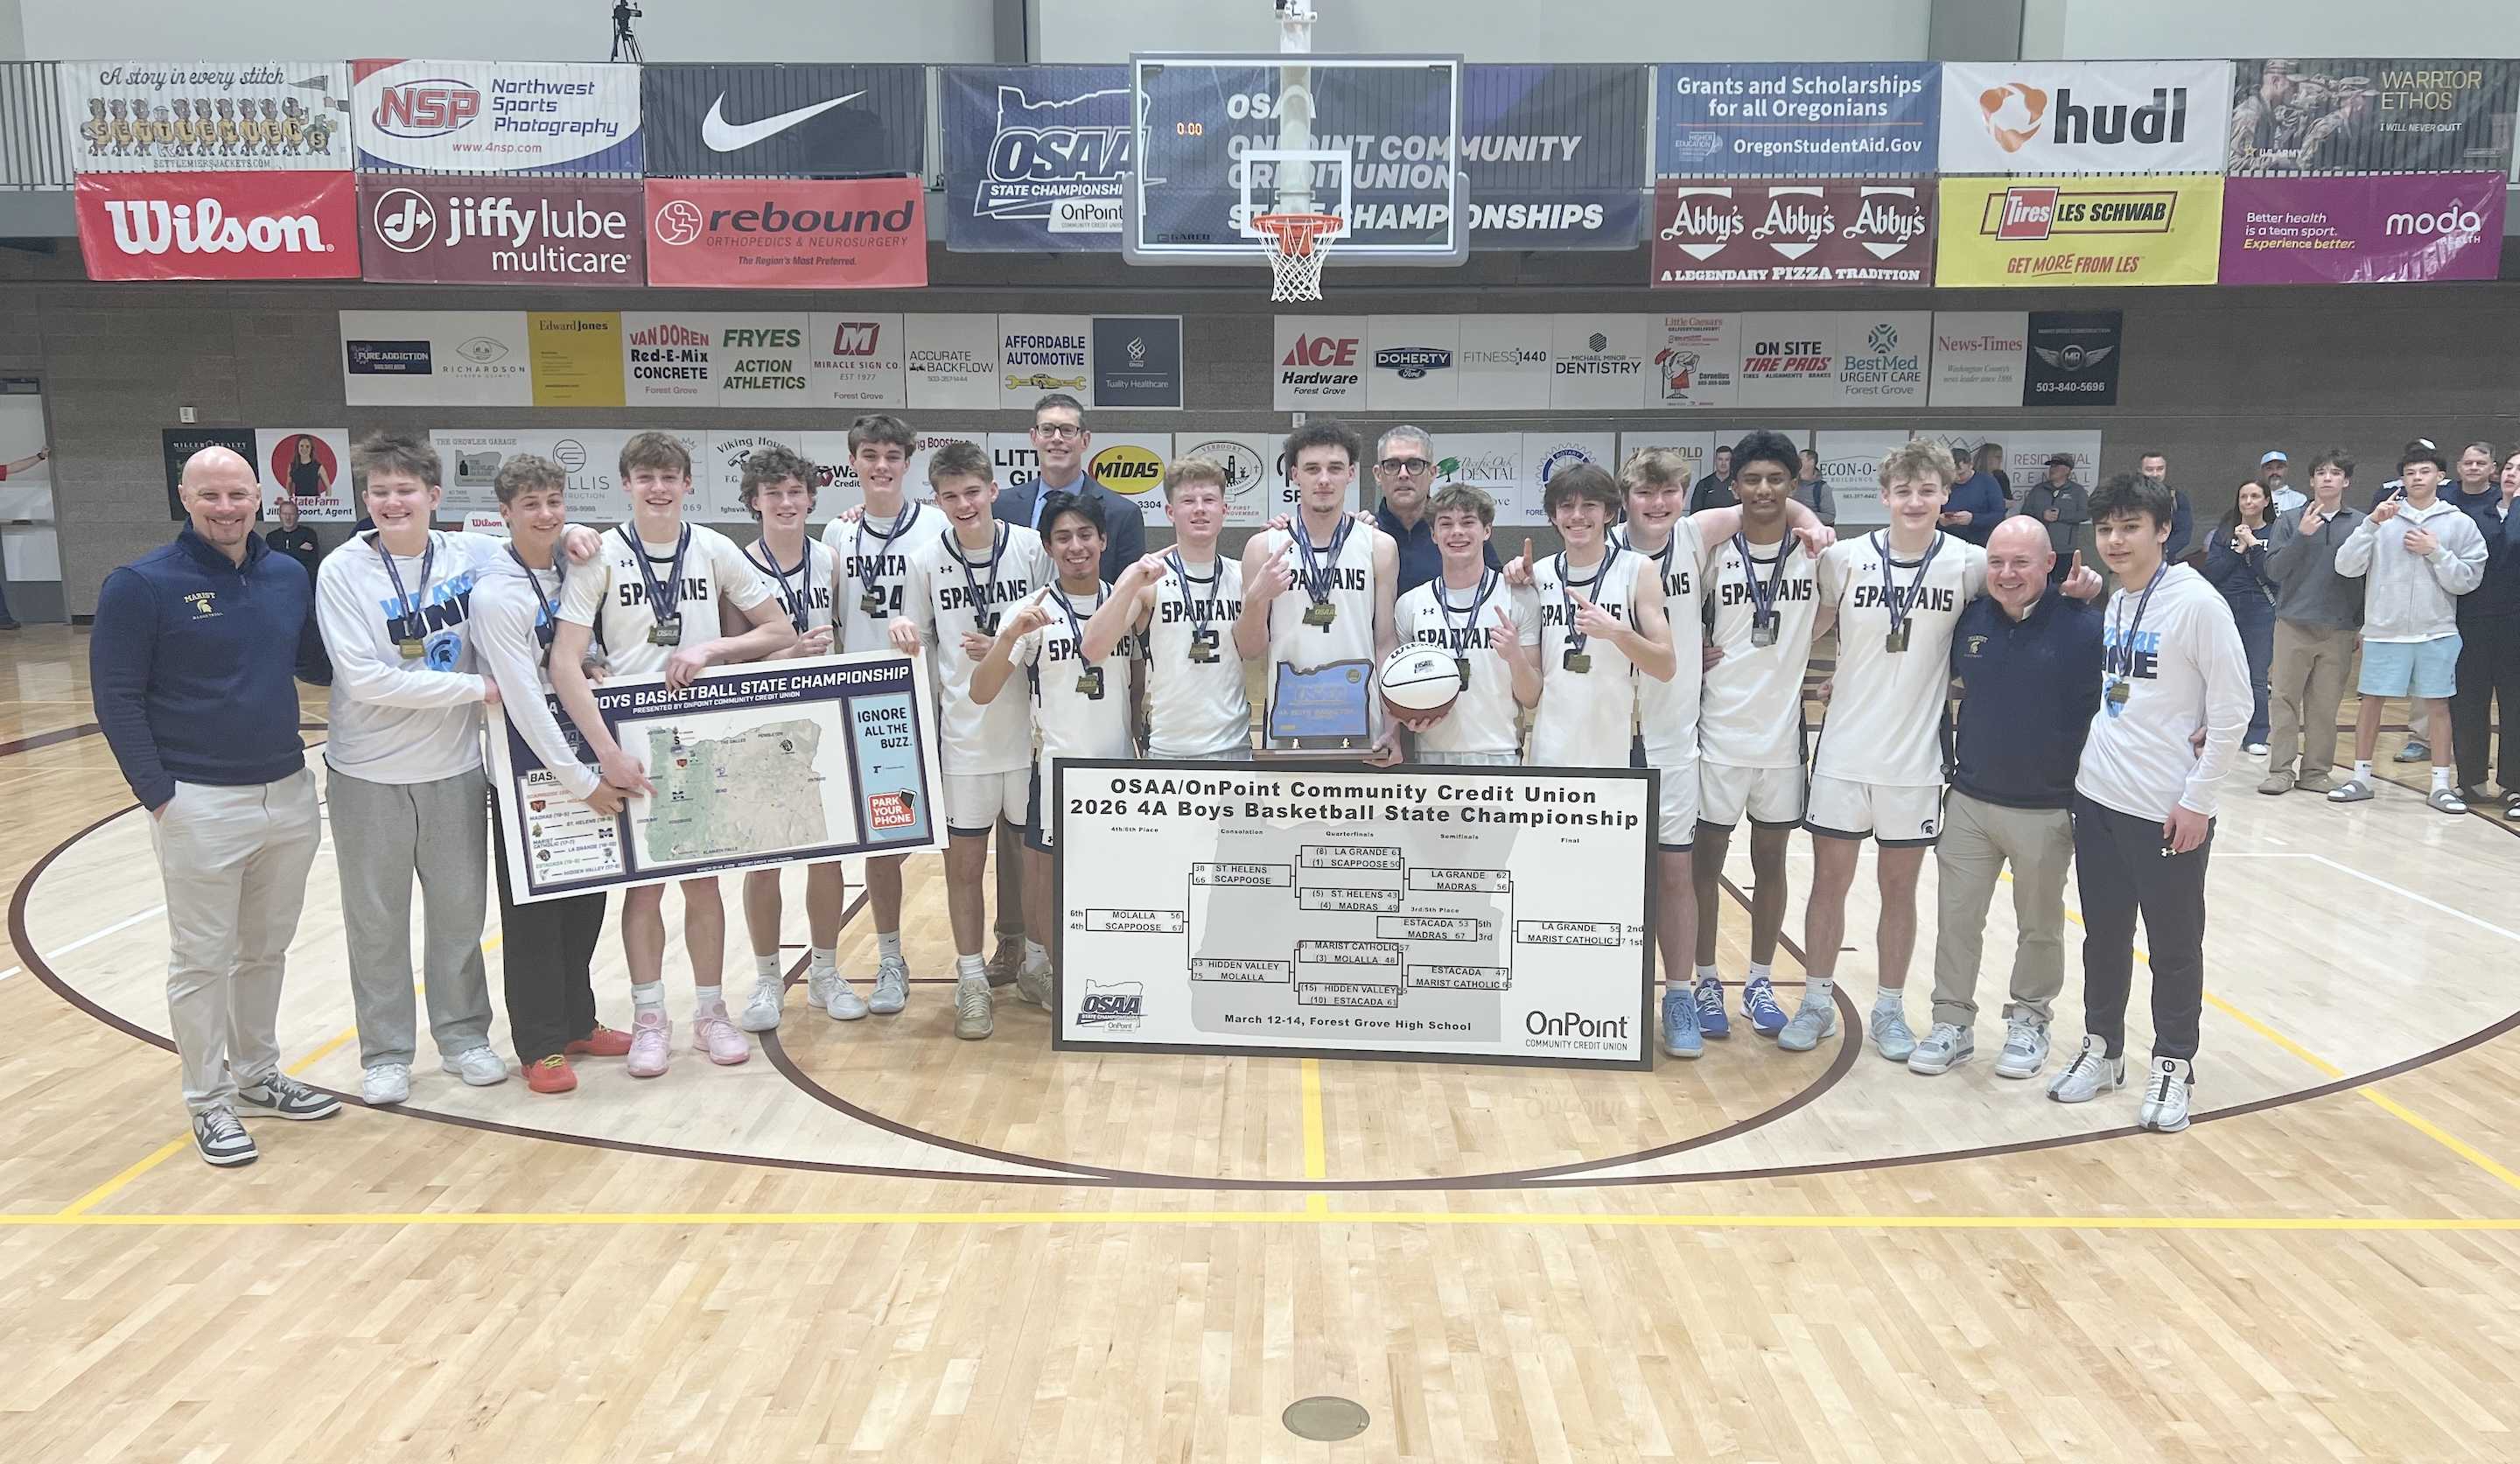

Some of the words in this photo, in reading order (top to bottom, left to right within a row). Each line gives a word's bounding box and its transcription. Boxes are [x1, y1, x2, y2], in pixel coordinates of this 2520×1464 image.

[100, 69, 122, 86] A
[125, 69, 167, 90] story
[171, 67, 186, 85] in
[189, 71, 234, 90] every
[240, 67, 284, 85] stitch
[2382, 70, 2482, 89] WARRIOR
[492, 78, 595, 95] Northwest
[1676, 77, 1744, 95] Grants
[1748, 76, 1786, 95] and
[1791, 75, 1922, 97] Scholarships
[492, 95, 557, 115] Sports
[2382, 92, 2453, 110] ETHOS
[379, 91, 480, 129] NSP
[1709, 98, 1738, 116] for
[1743, 98, 1767, 116] all
[1773, 99, 1888, 122] Oregonians
[2054, 88, 2187, 145] hudl
[494, 116, 619, 138] Photography
[2380, 123, 2385, 132] I
[2386, 123, 2407, 132] WILL
[2409, 123, 2436, 132] NEVER
[2437, 123, 2462, 132] QUIT
[452, 142, 542, 155] www.4nsp.com
[1733, 138, 1922, 157] OregonStudentAid.Gov
[990, 185, 1029, 196] STATE
[709, 200, 914, 233] rebound
[1061, 203, 1124, 221] OnPoint
[2007, 195, 2051, 224] Tires
[2056, 204, 2085, 222] LES
[2090, 202, 2167, 222] SCHWAB
[1661, 200, 1745, 243] Abby's
[1752, 200, 1836, 243] Abby's
[1842, 200, 1925, 243] Abby's
[2246, 213, 2284, 224] Better
[2286, 213, 2328, 224] health
[2385, 207, 2482, 236] moda
[104, 200, 327, 254] Wilson
[2245, 225, 2258, 236] is
[2258, 228, 2267, 236] a
[2269, 227, 2298, 236] team
[2301, 226, 2338, 240] sport.
[706, 236, 792, 248] ORTHOPEDICS
[795, 237, 803, 247] &
[808, 235, 908, 248] NEUROSURGERY
[2243, 239, 2313, 251] Experience
[2314, 238, 2356, 249] better.
[492, 246, 627, 273] multicare
[738, 256, 753, 265] The
[755, 256, 790, 266] Region's
[792, 256, 813, 265] Most
[2007, 256, 2032, 274] GET
[2032, 254, 2074, 273] MORE
[2074, 256, 2114, 274] FROM
[2116, 256, 2140, 274] LES
[1661, 270, 1673, 282] A
[1674, 270, 1767, 281] LEGENDARY
[1772, 266, 1833, 281] PIZZA
[1835, 269, 1921, 282] TRADITION
[629, 326, 658, 346] VAN
[660, 324, 710, 346] DOREN
[723, 329, 802, 347] FRYES
[1005, 336, 1086, 349] AFFORDABLE
[1282, 333, 1359, 366] ACE
[1755, 342, 1779, 355] ON
[1784, 341, 1822, 355] SITE
[1938, 335, 2023, 351] News-Times
[382, 352, 429, 361] ADDICTION
[631, 348, 709, 362] Red-E-Mix
[910, 351, 972, 361] ACCURATE
[1007, 352, 1085, 366] AUTOMOTIVE
[1377, 353, 1449, 366] DOHERTY
[735, 360, 793, 374] ACTION
[814, 361, 854, 369] MIRACLE
[927, 362, 994, 373] BACKFLOW
[1556, 362, 1641, 374] DENTISTRY
[1743, 357, 1783, 372] TIRE
[1783, 357, 1831, 372] PROS
[1844, 355, 1918, 370] BestMed
[634, 366, 709, 380] CONCRETE
[1282, 372, 1358, 386] Hardware
[1840, 373, 1893, 382] URGENT
[1895, 373, 1922, 382] CARE
[723, 376, 806, 389] ATHLETICS
[1106, 379, 1130, 389] Tuality
[1131, 379, 1169, 389] Healthcare
[645, 386, 672, 395] Forest
[673, 386, 698, 395] Grove
[717, 437, 754, 455] Viking
[1096, 461, 1160, 478] MIDAS
[1460, 467, 1517, 480] DENTAL
[326, 508, 353, 518] Agent
[472, 518, 502, 528] Wilson
[635, 685, 738, 707] BASKETBALL
[740, 678, 788, 695] STATE
[791, 666, 910, 690] CHAMPIONSHIP
[633, 702, 673, 714] PRESENTED
[674, 702, 682, 711] BY
[714, 696, 754, 707] COMMUNITY
[755, 693, 779, 703] CREDIT
[780, 690, 801, 700] UNION
[857, 707, 907, 724] IGNORE
[864, 725, 886, 737] ALL
[887, 723, 907, 735] THE
[880, 735, 913, 749] BUZZ.
[1110, 778, 1280, 797] OSAA/OnPoint
[1291, 781, 1427, 802] Community
[1438, 784, 1514, 802] Credit
[1524, 787, 1596, 803] Union
[872, 797, 899, 809] PARK
[873, 805, 902, 816] YOUR
[1070, 800, 1127, 815] 2026
[1138, 801, 1167, 816] 4A
[1178, 802, 1234, 821] Boys
[1245, 803, 1374, 821] Basketball
[1385, 805, 1450, 821] State
[1460, 807, 1639, 830] Championship
[874, 813, 912, 826] PHONE
[1112, 911, 1156, 920] MOLALLA
[1105, 923, 1162, 932] SCAPPOOSE
[1404, 919, 1453, 928] ESTACADA
[1542, 922, 1555, 932] LA
[1557, 923, 1597, 933] GRANDE
[1528, 934, 1564, 943] MARIST
[1565, 935, 1614, 944] CATHOLIC
[1225, 1014, 1263, 1025] March
[1268, 1016, 1306, 1026] 12-14,
[1310, 1017, 1349, 1026] Forest
[1354, 1019, 1390, 1028] Grove
[1395, 1019, 1424, 1030] High
[1429, 1020, 1472, 1031] School
[1525, 1011, 1628, 1039] OnPoint
[1525, 1039, 1572, 1050] COMMUNITY
[1573, 1040, 1601, 1050] CREDIT
[1602, 1040, 1628, 1051] UNION
